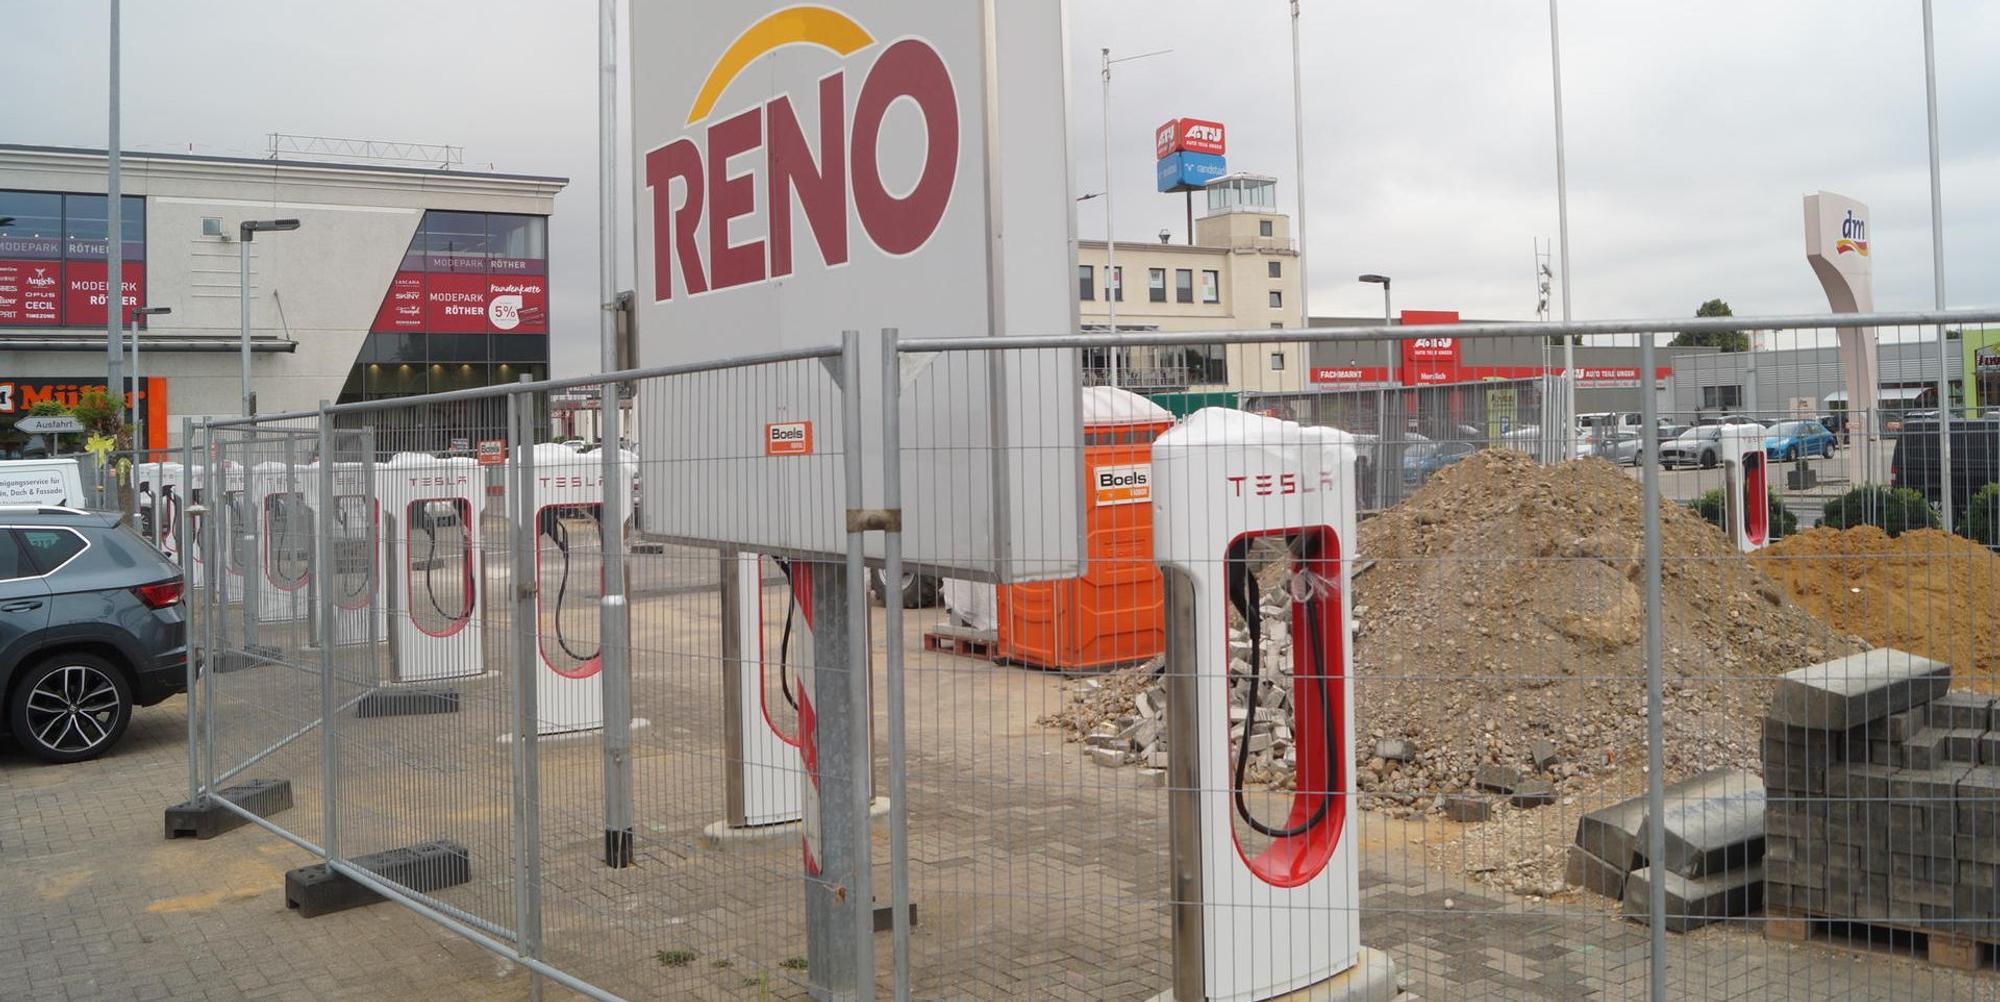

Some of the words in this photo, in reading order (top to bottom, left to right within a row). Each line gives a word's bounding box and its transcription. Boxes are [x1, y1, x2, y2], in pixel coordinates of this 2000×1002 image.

[1185, 125, 1222, 142] ATU
[645, 37, 960, 302] RENO
[1842, 209, 1865, 240] dm
[69, 244, 109, 254] RÖTHE
[434, 259, 483, 268] MODEPARK
[490, 260, 526, 269] RÖTHER
[71, 281, 137, 291] MODERK
[90, 294, 137, 306] RÖER
[430, 292, 484, 303] MODEPARK
[25, 301, 55, 310] CECIL
[445, 306, 484, 316] RÖTHER
[495, 305, 516, 318] 5%
[1320, 370, 1362, 379] FACHMARKT
[36, 420, 73, 429] Ausfahrt
[772, 427, 803, 440] Boels
[409, 475, 467, 487] TESLA
[1100, 471, 1147, 487] Boels
[1227, 470, 1333, 497] TESLA
[36, 487, 63, 496] Fassade
